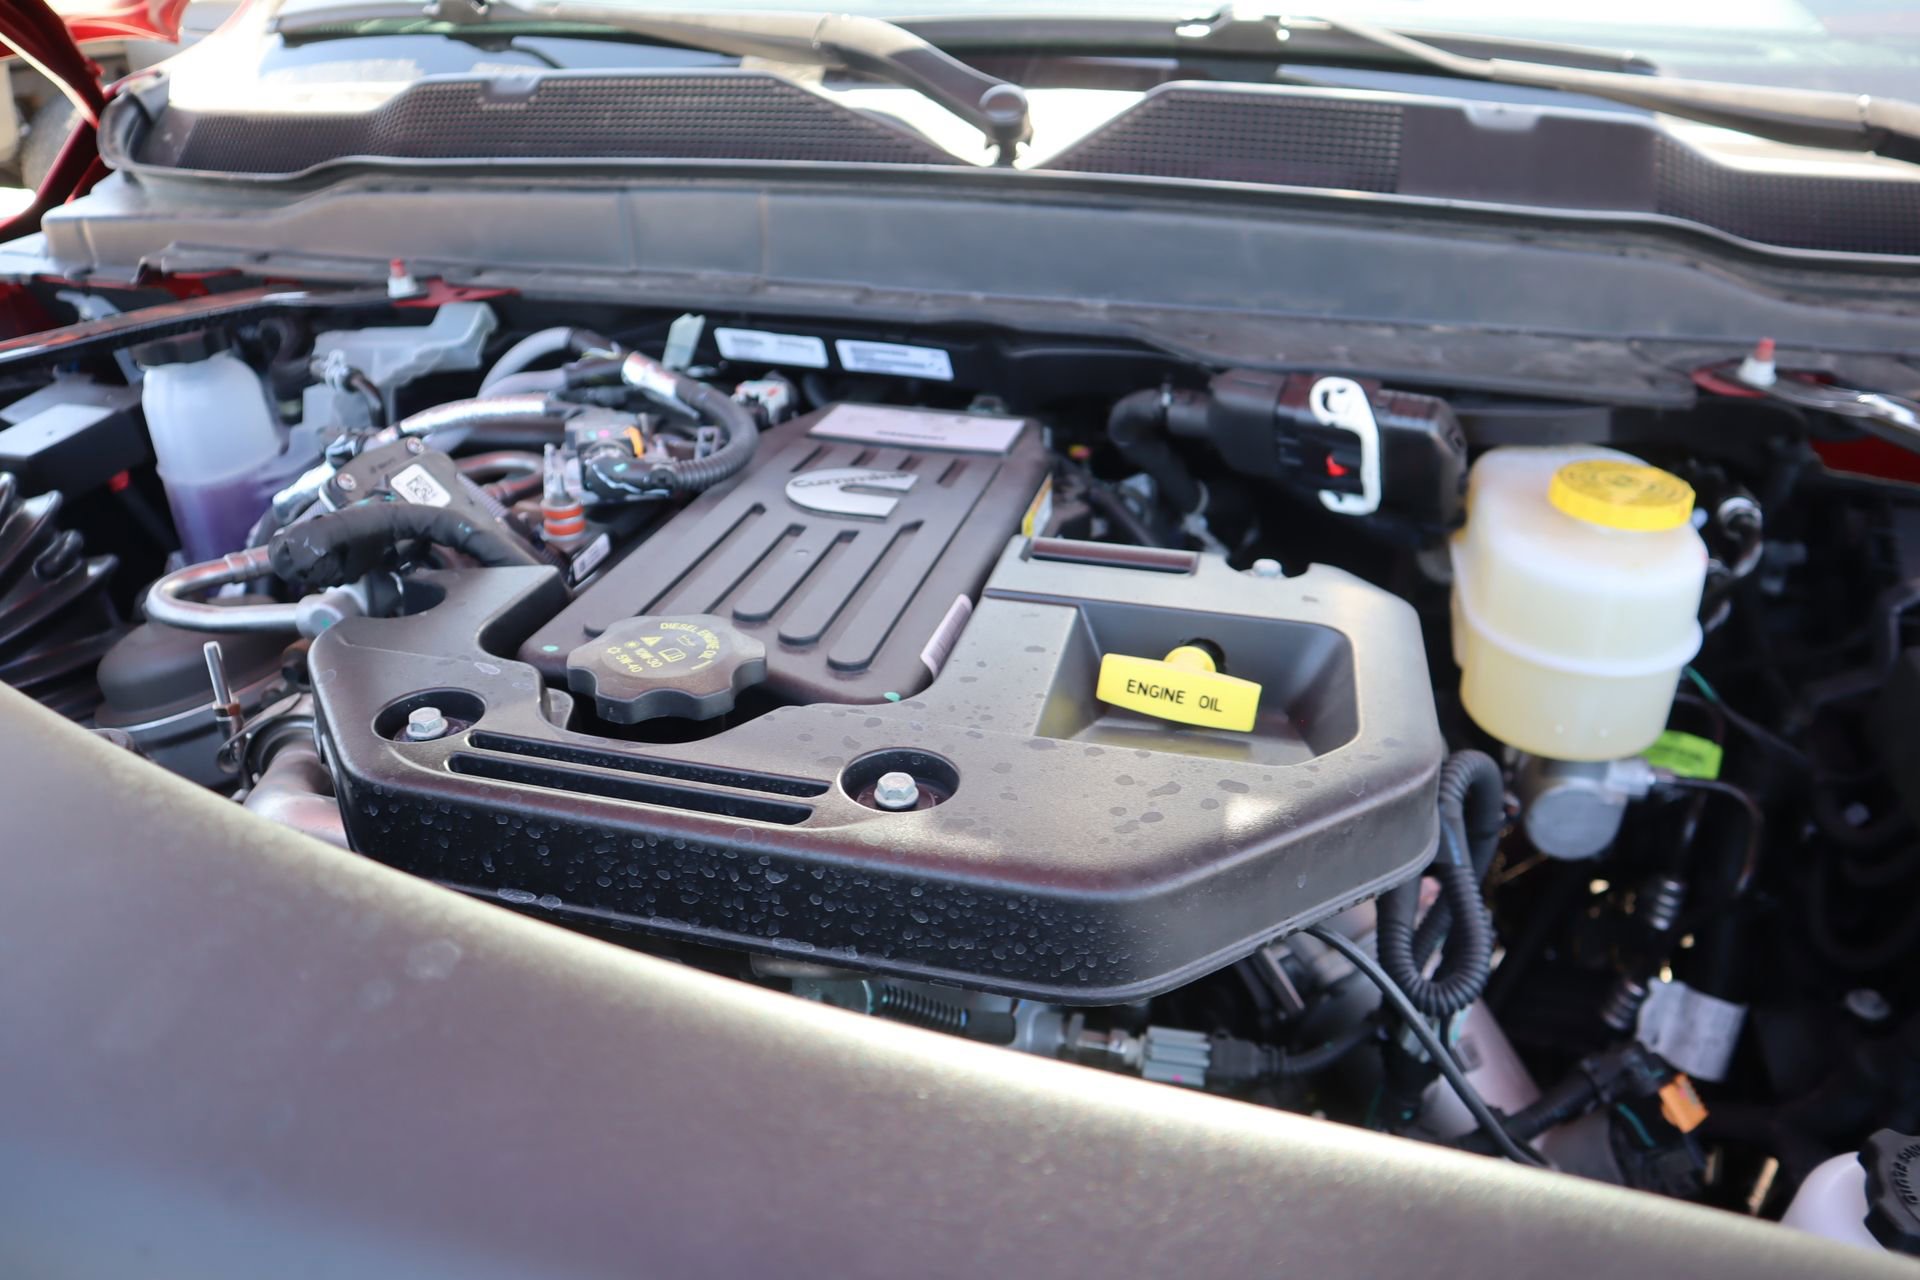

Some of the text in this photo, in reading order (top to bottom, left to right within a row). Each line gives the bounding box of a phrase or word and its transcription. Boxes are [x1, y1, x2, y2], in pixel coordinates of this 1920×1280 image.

[660, 622, 699, 633] DIESEL
[615, 654, 643, 673] 5W-40
[1126, 678, 1223, 713] ENGINE OIL
